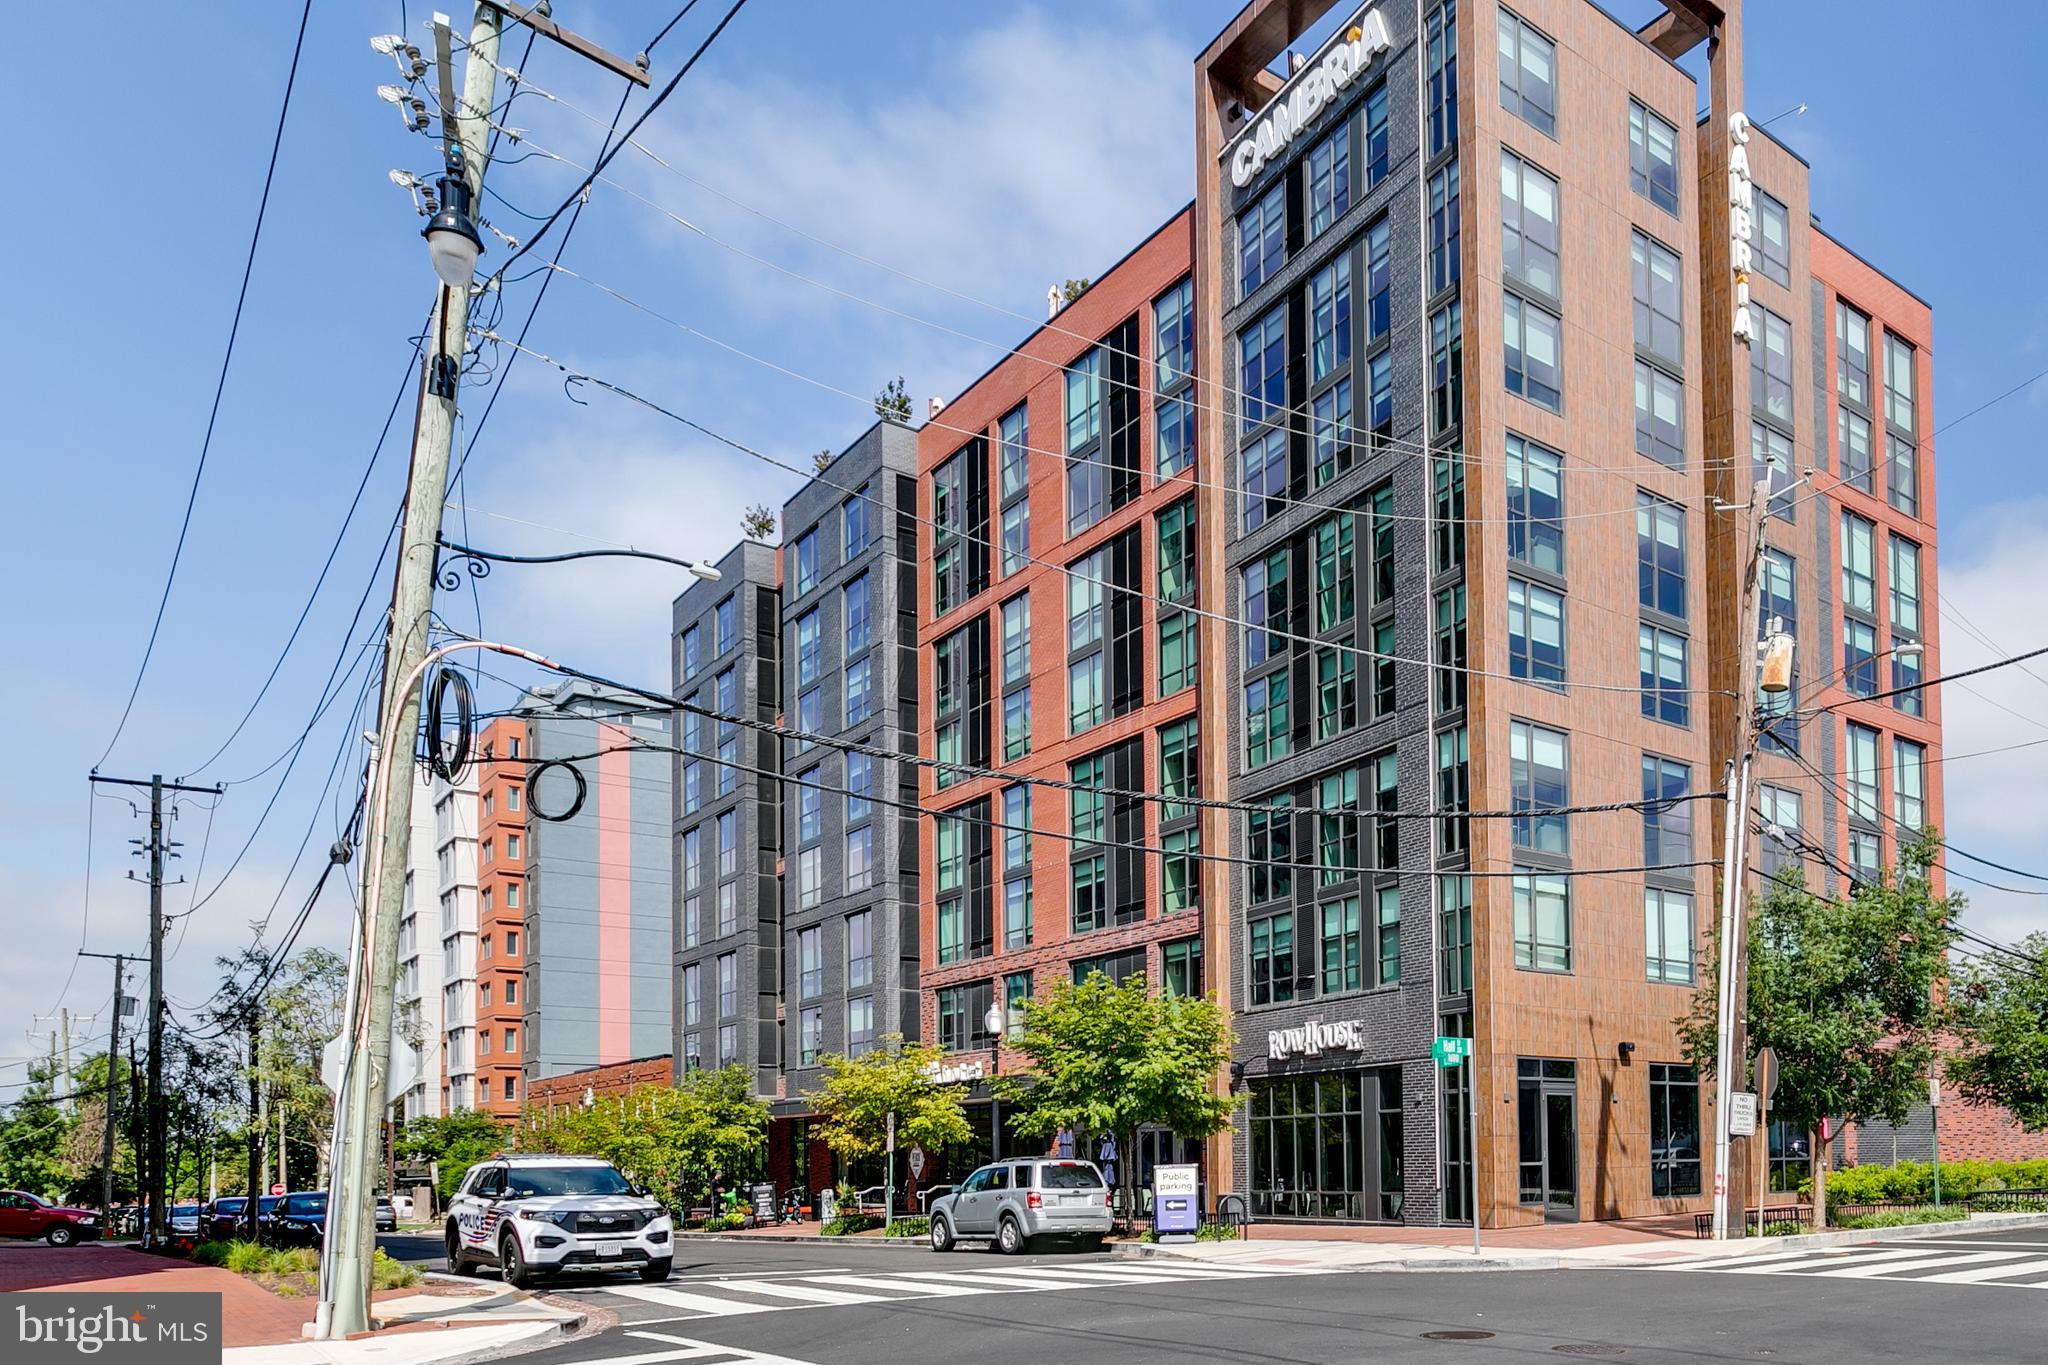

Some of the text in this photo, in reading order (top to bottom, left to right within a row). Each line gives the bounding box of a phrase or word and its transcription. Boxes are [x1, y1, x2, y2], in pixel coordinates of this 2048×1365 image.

[1162, 1172, 1189, 1180] Public
[1160, 1183, 1192, 1192] parking
[459, 1213, 485, 1231] POLICE
